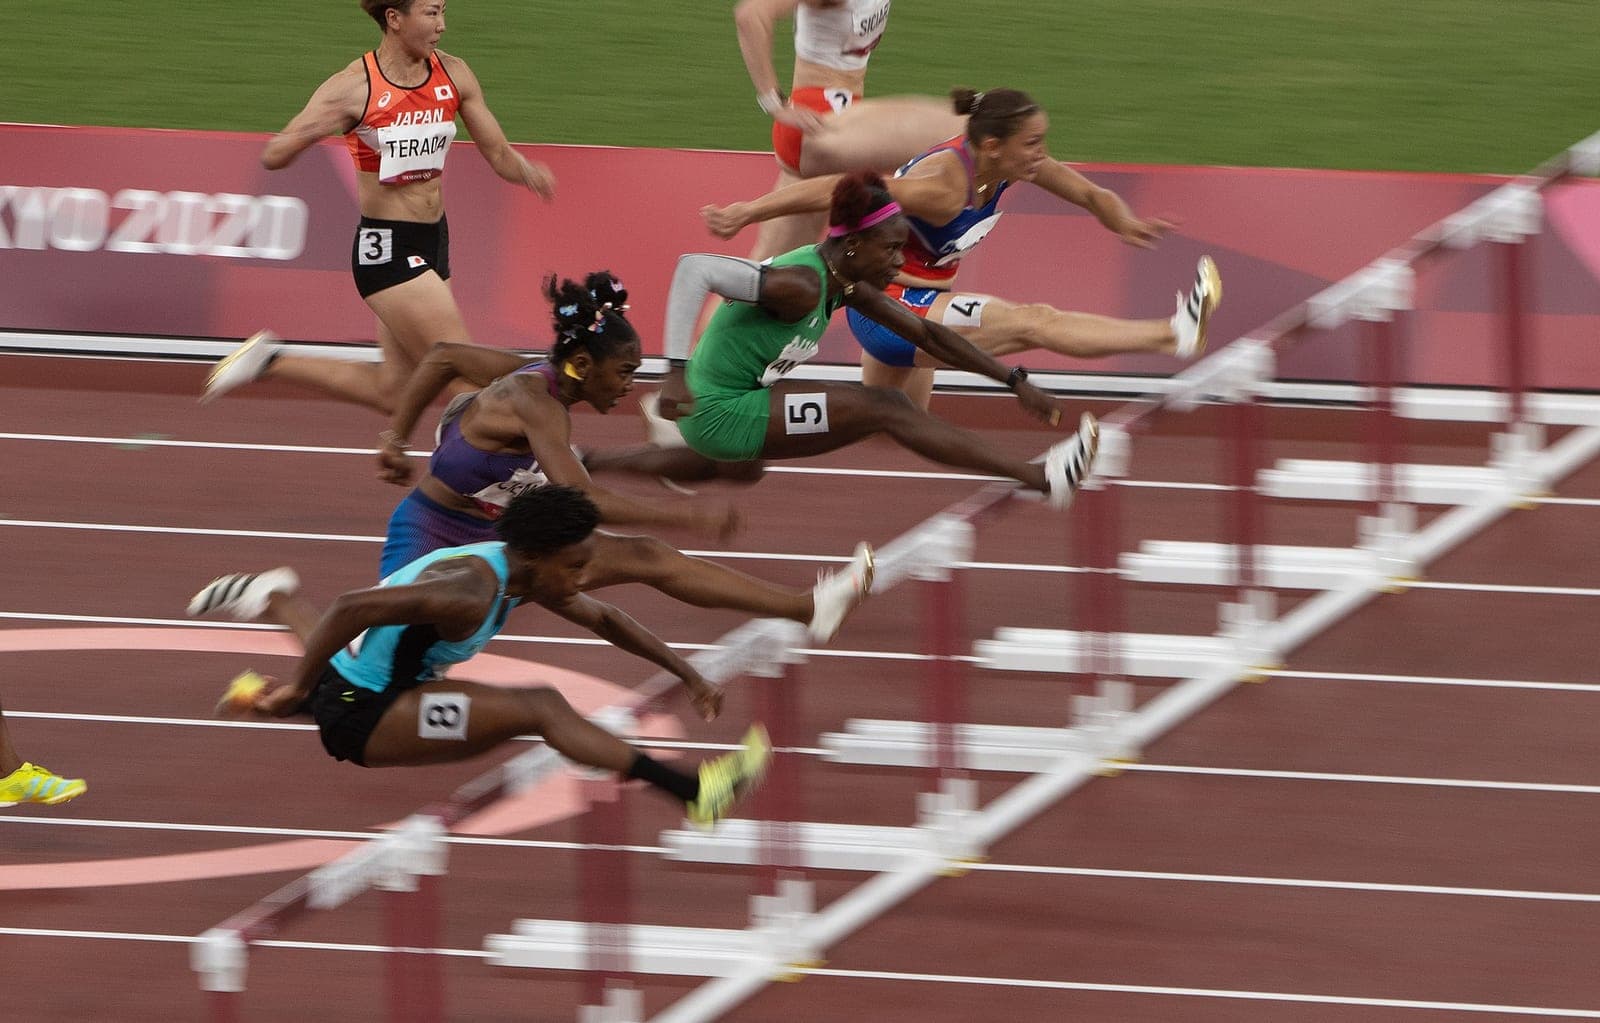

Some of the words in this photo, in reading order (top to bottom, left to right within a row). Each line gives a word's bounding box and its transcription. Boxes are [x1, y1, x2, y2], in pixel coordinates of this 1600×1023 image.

[390, 107, 444, 127] JAPAN
[385, 135, 447, 158] TERADA
[104, 189, 308, 260] 2020
[364, 231, 383, 261] 3
[951, 301, 982, 318] 4
[788, 402, 822, 425] 5
[425, 703, 462, 728] 8
